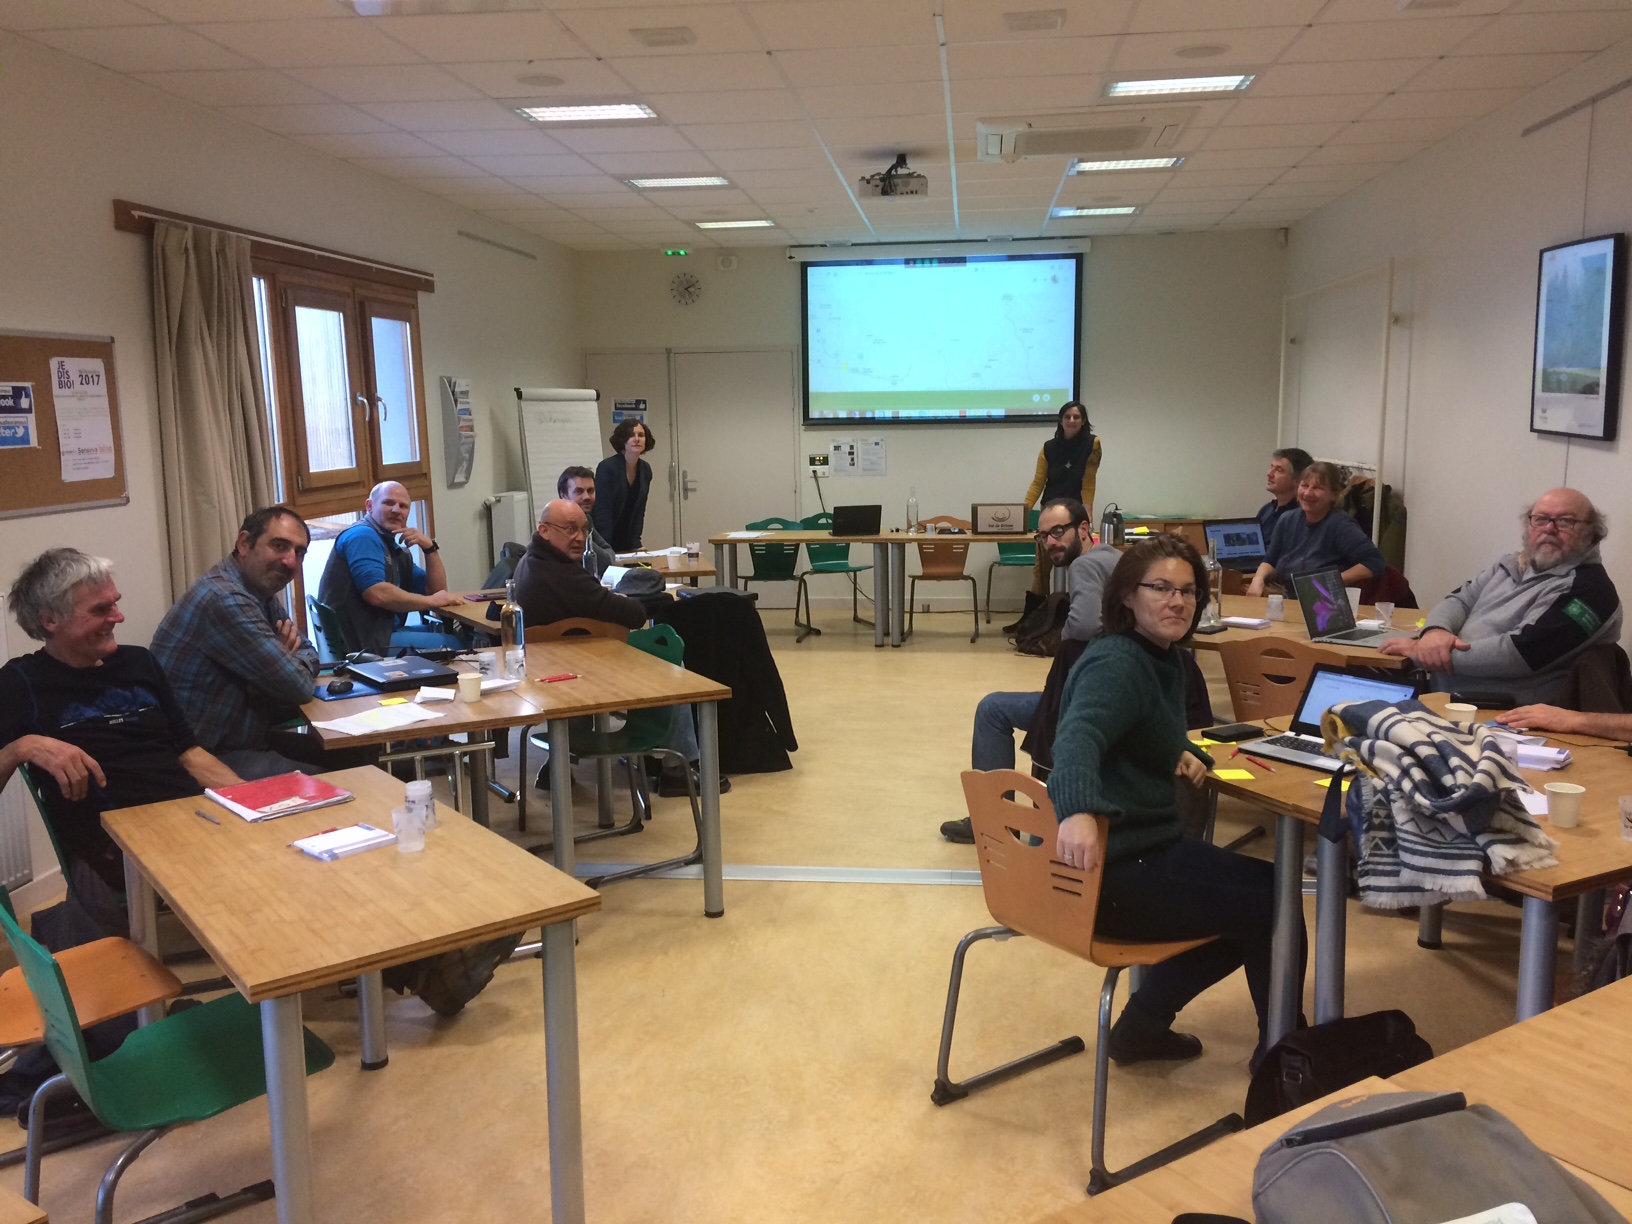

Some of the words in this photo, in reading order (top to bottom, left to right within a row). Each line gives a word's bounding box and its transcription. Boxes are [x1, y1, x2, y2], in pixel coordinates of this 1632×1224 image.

[57, 360, 66, 370] JE
[57, 370, 71, 380] DIS
[79, 374, 101, 386] 2017
[58, 379, 75, 390] BIO!
[0, 395, 15, 407] ook
[0, 427, 15, 437] ter
